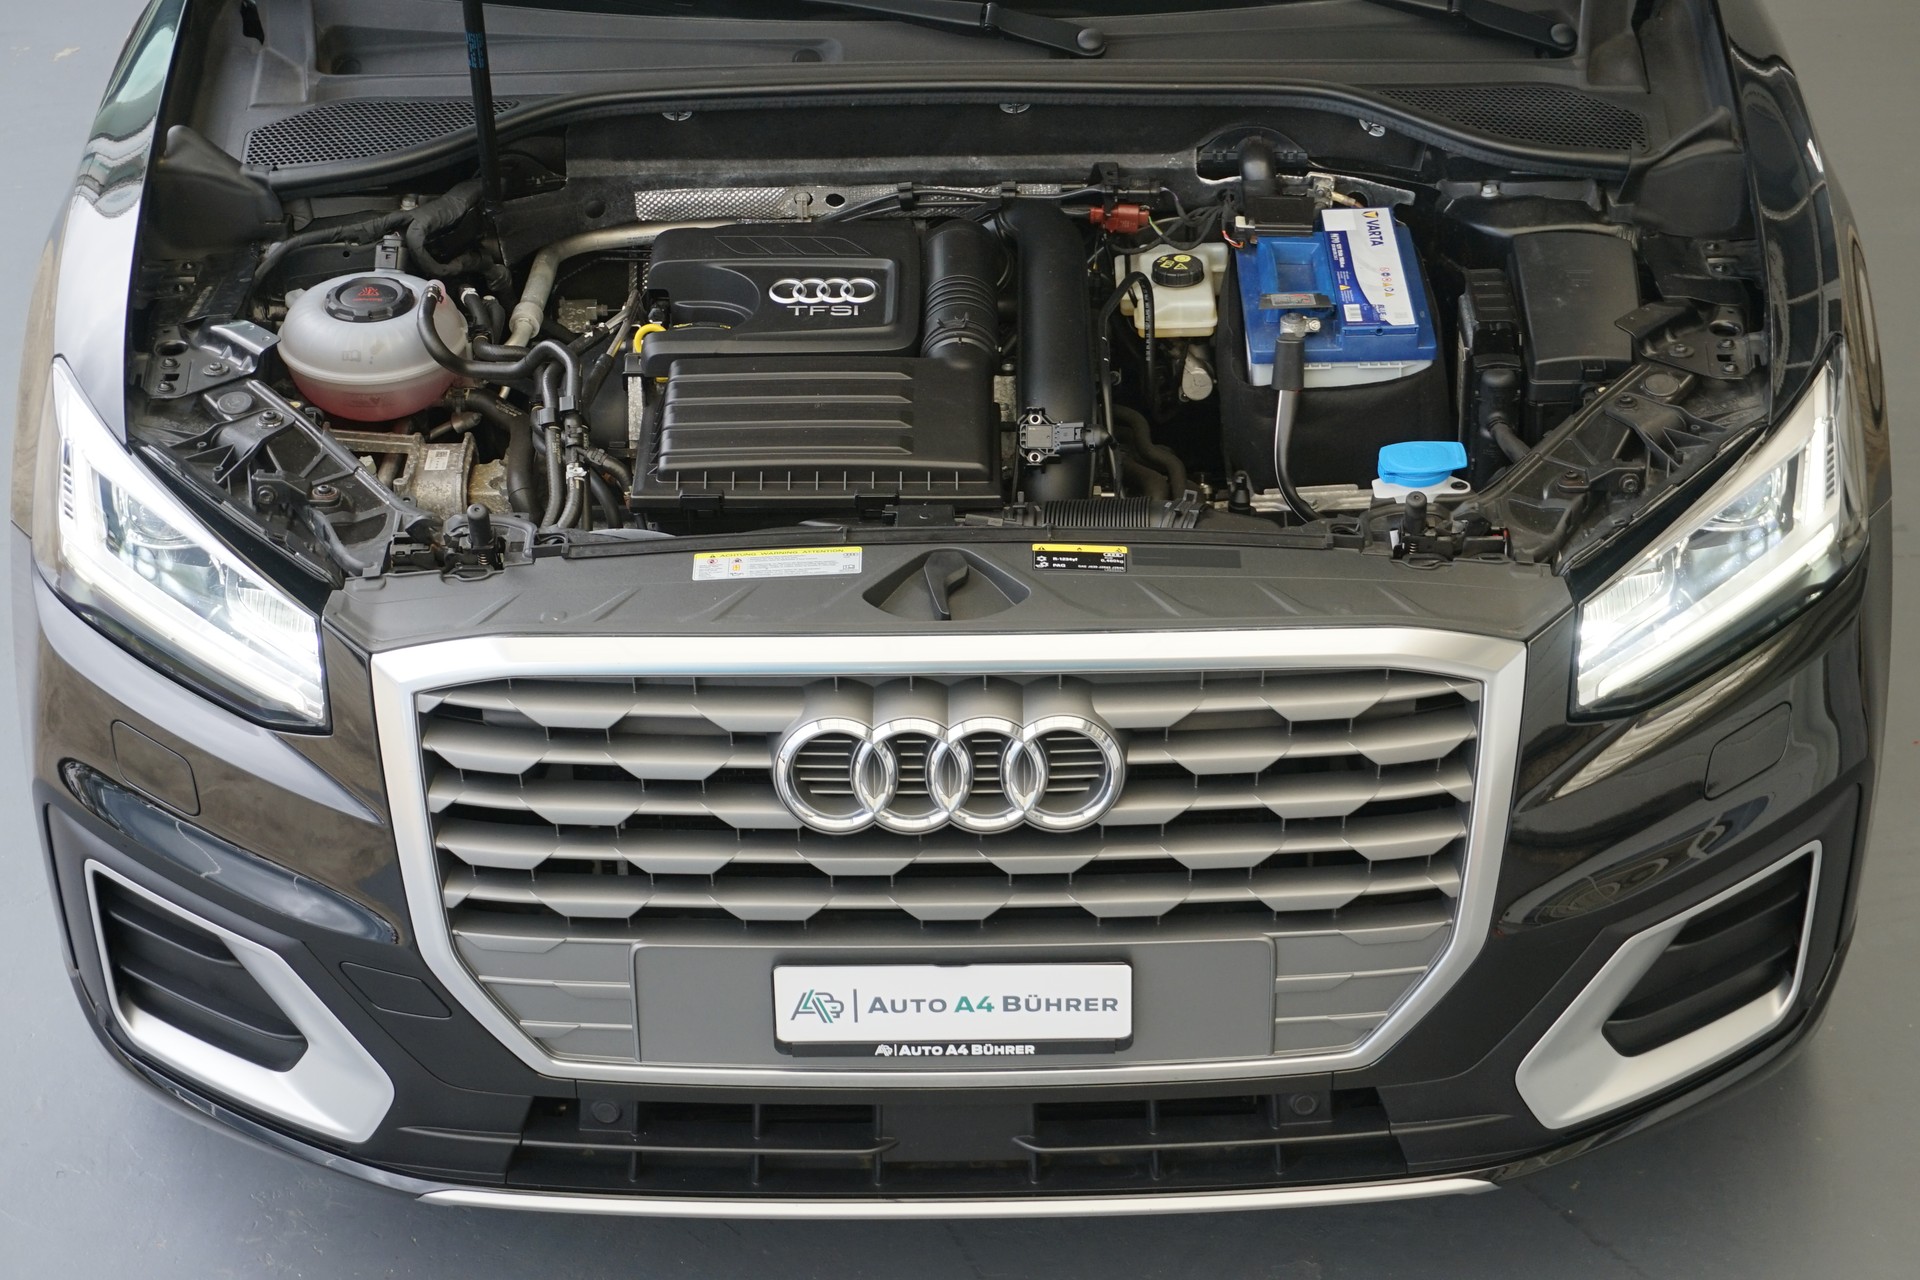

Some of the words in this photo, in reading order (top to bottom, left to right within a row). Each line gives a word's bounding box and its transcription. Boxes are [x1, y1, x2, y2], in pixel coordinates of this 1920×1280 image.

[1366, 219, 1384, 247] VARTA
[786, 305, 859, 316] TFSI
[954, 995, 995, 1013] A4
[1002, 994, 1118, 1012] BÜHRER
[945, 1044, 968, 1055] A4
[971, 1043, 1035, 1055] BÜHRER
